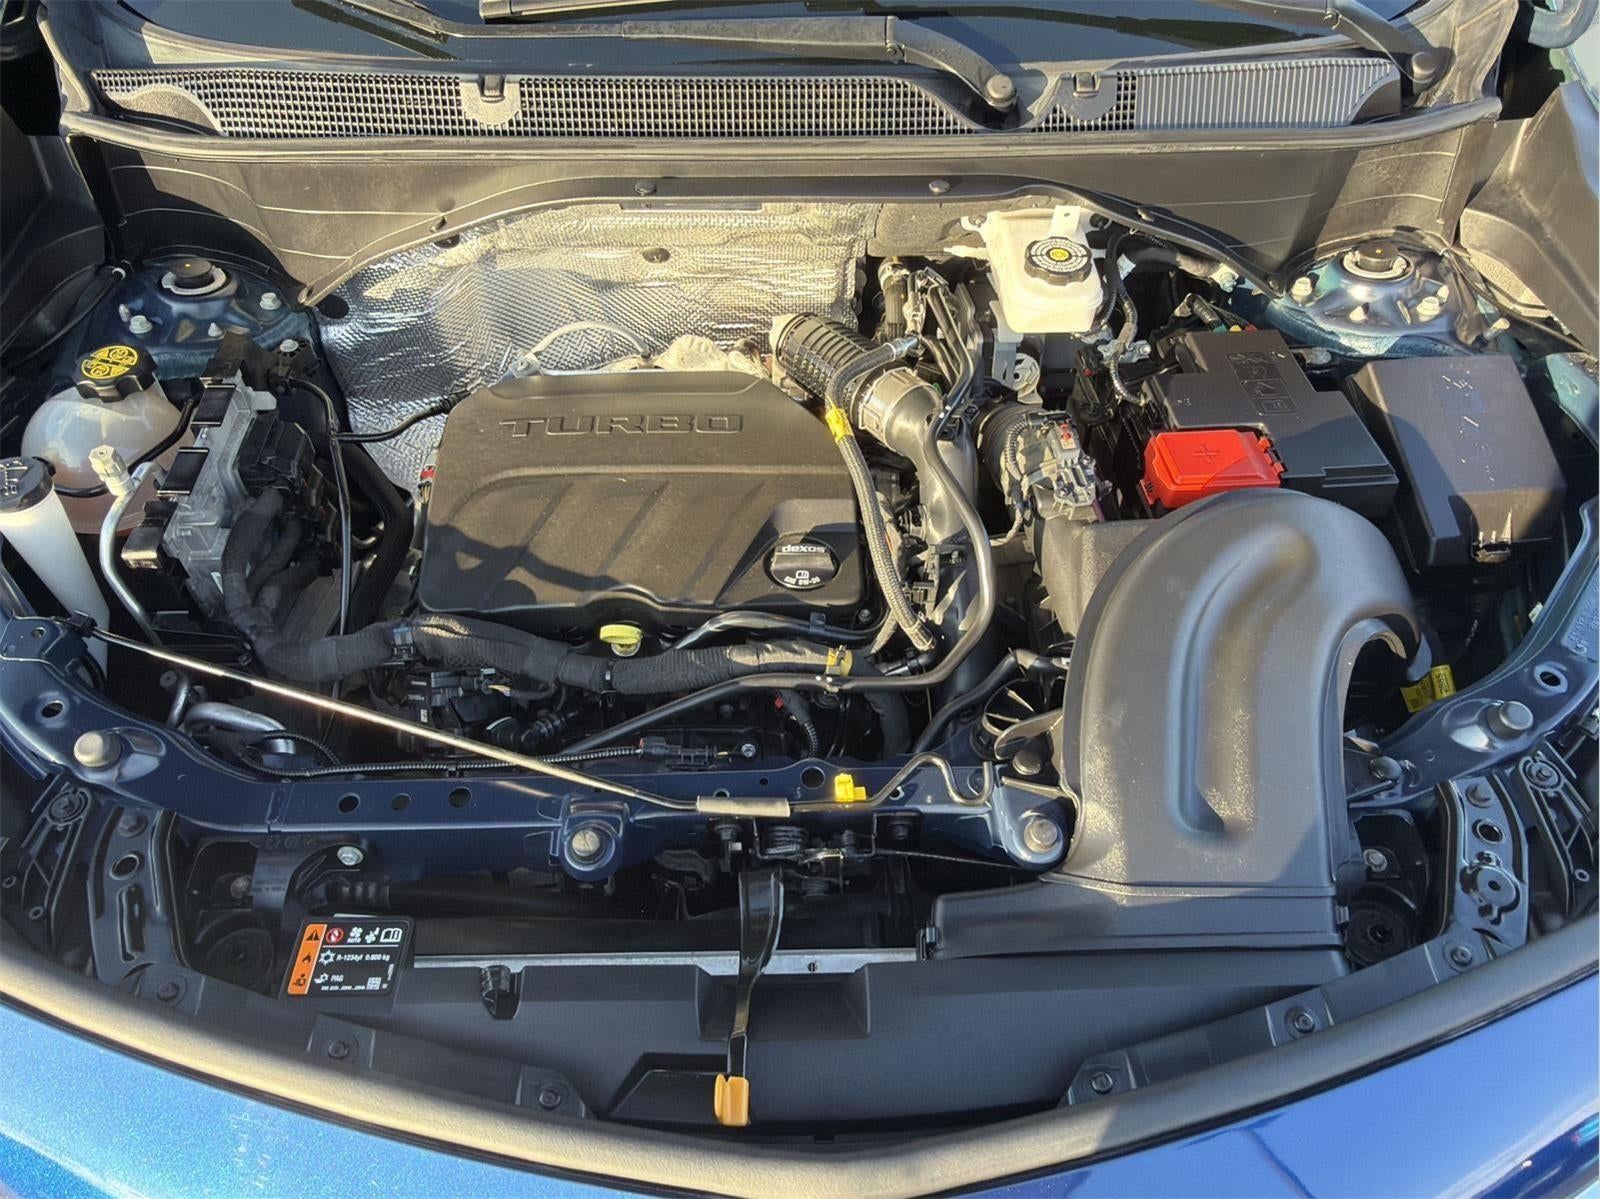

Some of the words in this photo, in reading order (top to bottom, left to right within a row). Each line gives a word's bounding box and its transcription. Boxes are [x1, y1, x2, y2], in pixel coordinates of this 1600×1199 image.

[499, 414, 743, 438] TURBO
[781, 544, 826, 553] dexos
[330, 974, 344, 982] PAG
